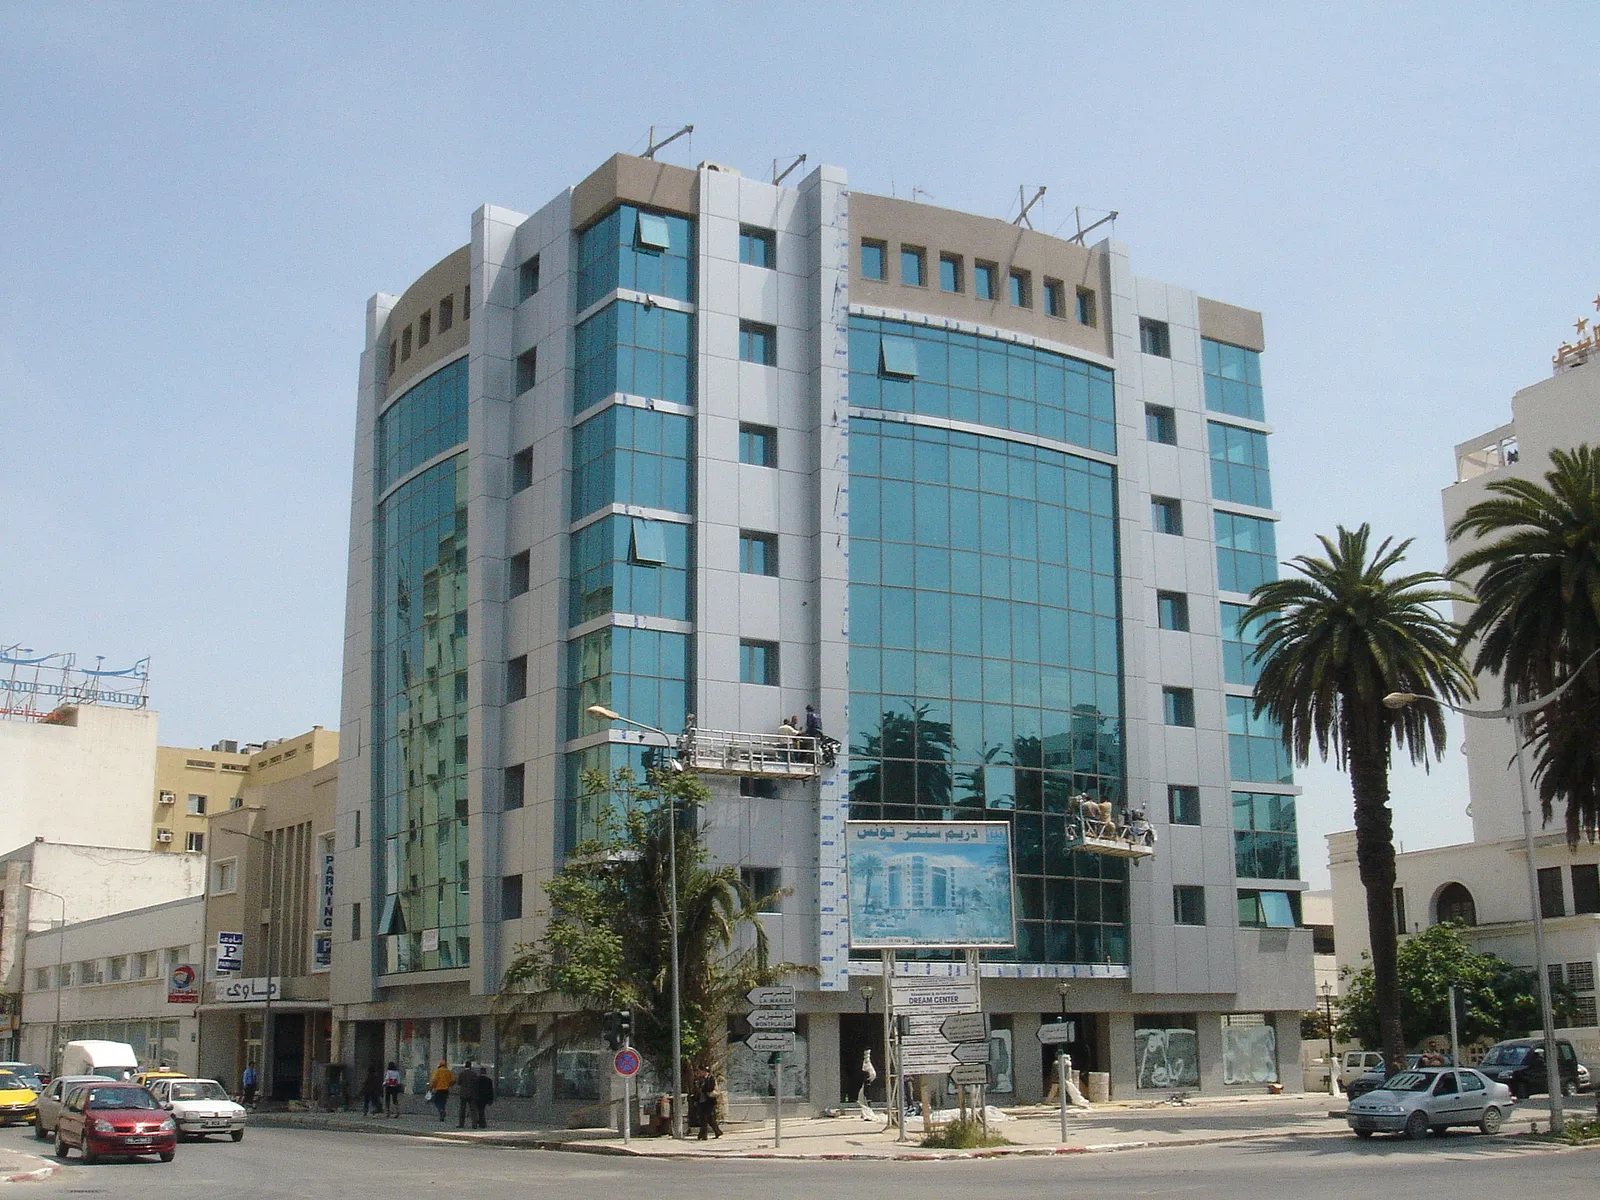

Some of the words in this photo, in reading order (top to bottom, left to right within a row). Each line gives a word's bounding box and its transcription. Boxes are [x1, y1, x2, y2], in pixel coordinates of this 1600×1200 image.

[857, 824, 896, 840] تونس
[903, 826, 941, 841] سنتر
[323, 855, 334, 927] PARKING
[224, 945, 237, 958] P
[909, 996, 933, 1004] DREAM
[934, 995, 959, 1003] CENTER
